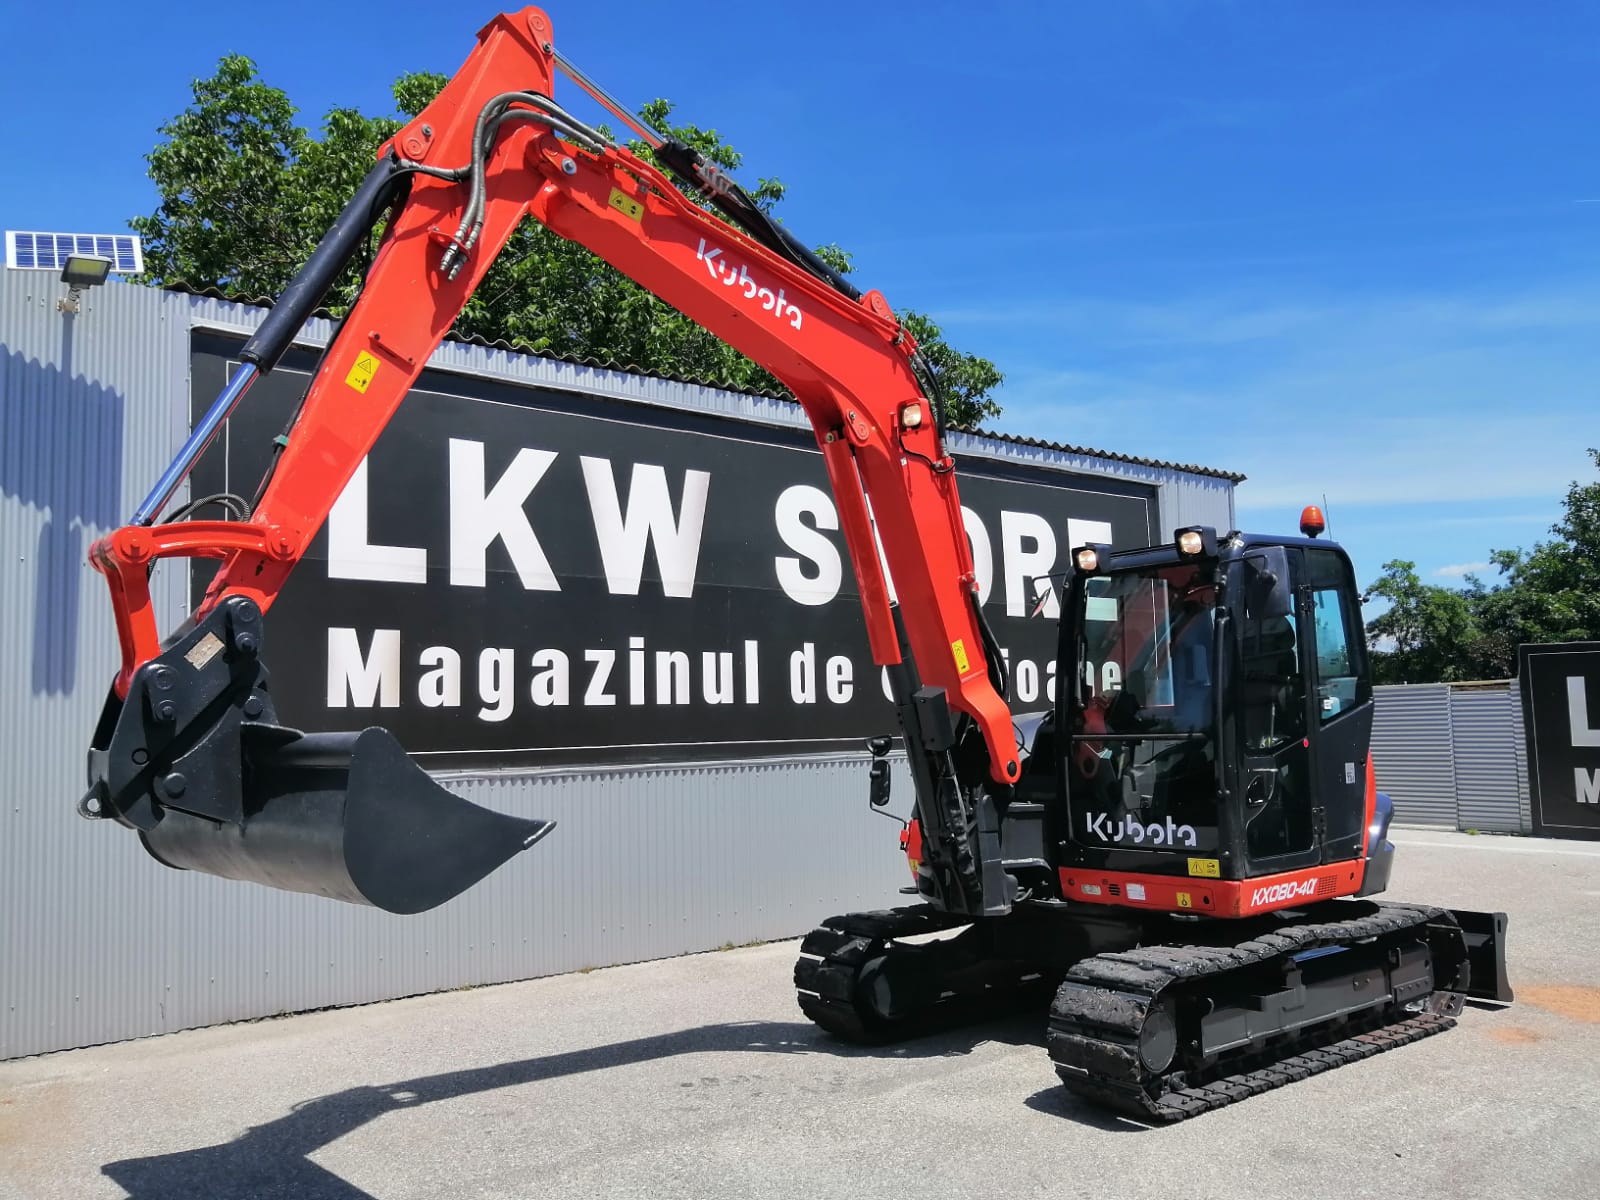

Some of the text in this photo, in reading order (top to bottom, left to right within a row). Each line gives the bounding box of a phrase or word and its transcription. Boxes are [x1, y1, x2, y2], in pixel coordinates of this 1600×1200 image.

[696, 238, 803, 331] Kubota
[327, 437, 1118, 621] LKW SRE
[326, 626, 760, 723] Magazinul
[790, 642, 854, 704] de
[1086, 811, 1197, 847] Kubota
